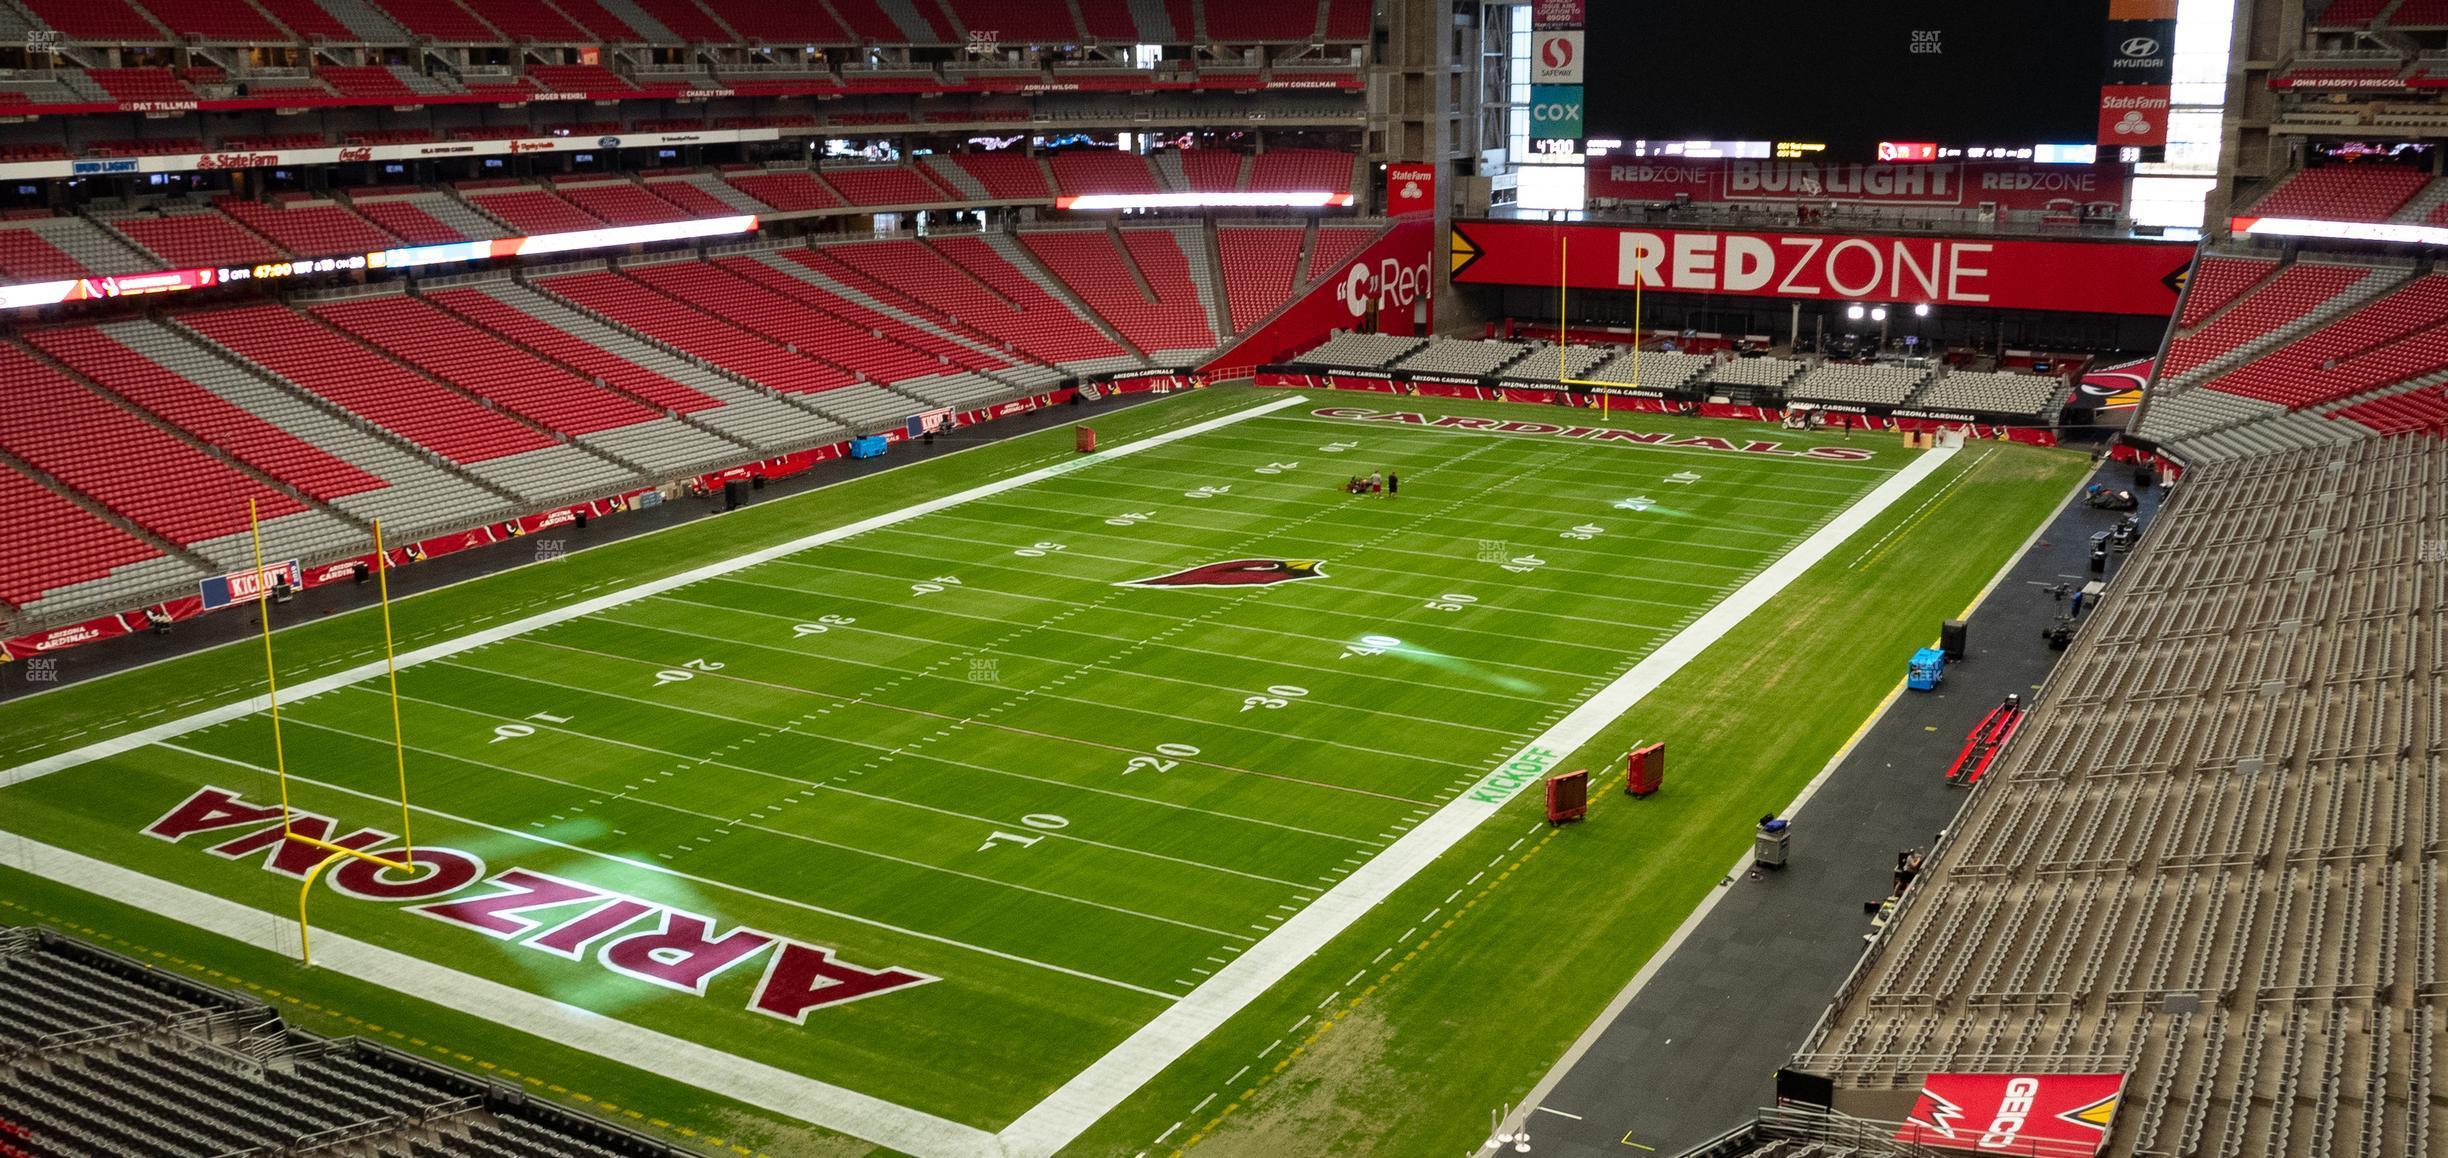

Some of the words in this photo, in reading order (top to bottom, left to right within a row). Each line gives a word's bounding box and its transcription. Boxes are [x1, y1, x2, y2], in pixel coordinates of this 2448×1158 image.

[2113, 58, 2164, 68] HYUNDAI
[2291, 79, 2316, 87] JOHN
[2318, 79, 2358, 88] (PADDY)
[2360, 79, 2408, 88] DRISCOLL
[561, 92, 587, 100] WEHRLI
[133, 102, 152, 110] PAT
[156, 102, 198, 110] TILLMAN
[1534, 104, 1580, 121] COX
[602, 138, 618, 146] Ford
[102, 161, 137, 171] LIGHT
[1732, 160, 1820, 192] BUD
[1826, 162, 1953, 195] LIGHT
[1379, 250, 1432, 310] Red
[1113, 372, 1138, 380] ARIZONA
[1442, 377, 1478, 385] CARDINALS
[1530, 383, 1568, 391] CARDINALS
[1624, 390, 1663, 398] CARDINALS
[1822, 404, 1866, 413] CARDINALS
[1892, 410, 1927, 418] ARIZONA
[1928, 412, 1974, 422] CARDINALS
[1310, 407, 1877, 461] CARDINALS
[1254, 462, 1297, 474] 20
[540, 514, 576, 527] CARDINAL
[548, 510, 572, 518] ARIZONA
[1104, 512, 1148, 526] 40
[1560, 526, 1605, 540] 30
[1014, 541, 1067, 557] 50
[1501, 557, 1546, 573] 40
[320, 568, 355, 582] CARDIN
[911, 575, 962, 592] 40
[1424, 594, 1478, 612] 50
[792, 614, 856, 634] 30
[36, 629, 100, 650] CARDINALS
[48, 626, 86, 640] ARIZONA
[1346, 635, 1400, 656] 40
[655, 658, 726, 682] 20
[1244, 685, 1309, 709] 30
[494, 710, 574, 737] 10
[1128, 743, 1200, 773] 20
[1468, 746, 1557, 804] KICKOFF
[986, 814, 1070, 849] 10
[139, 784, 944, 1026] ARIZONA
[1979, 1078, 2039, 1148] GEICO
